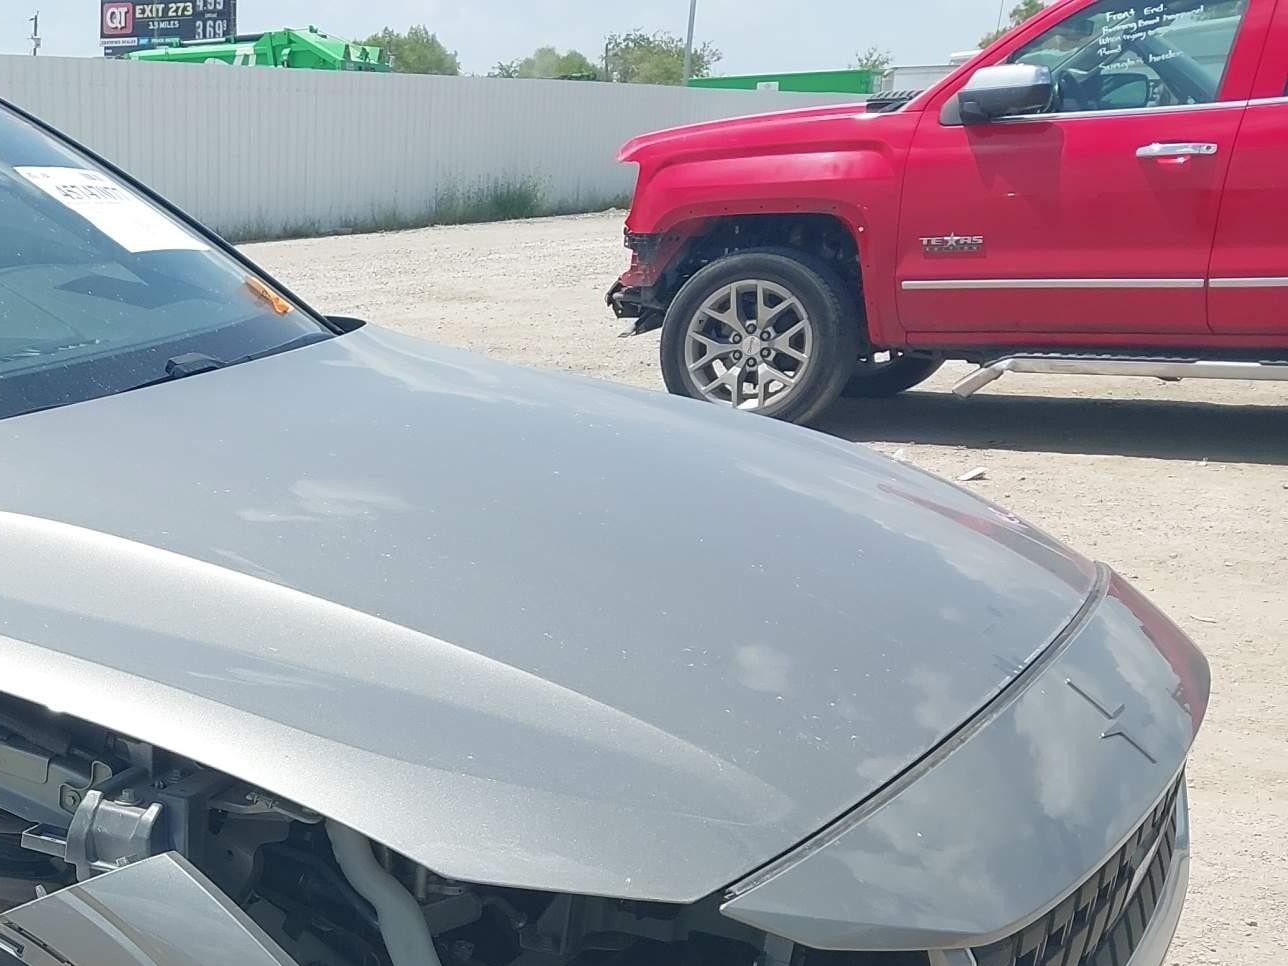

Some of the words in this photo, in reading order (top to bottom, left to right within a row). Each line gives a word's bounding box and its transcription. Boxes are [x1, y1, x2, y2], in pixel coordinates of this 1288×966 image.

[135, 5, 163, 18] EXIT
[168, 3, 193, 16] 273
[1105, 8, 1135, 22] Front
[106, 8, 128, 30] QT
[160, 20, 180, 28] MILES
[919, 232, 984, 246] TEXAS
